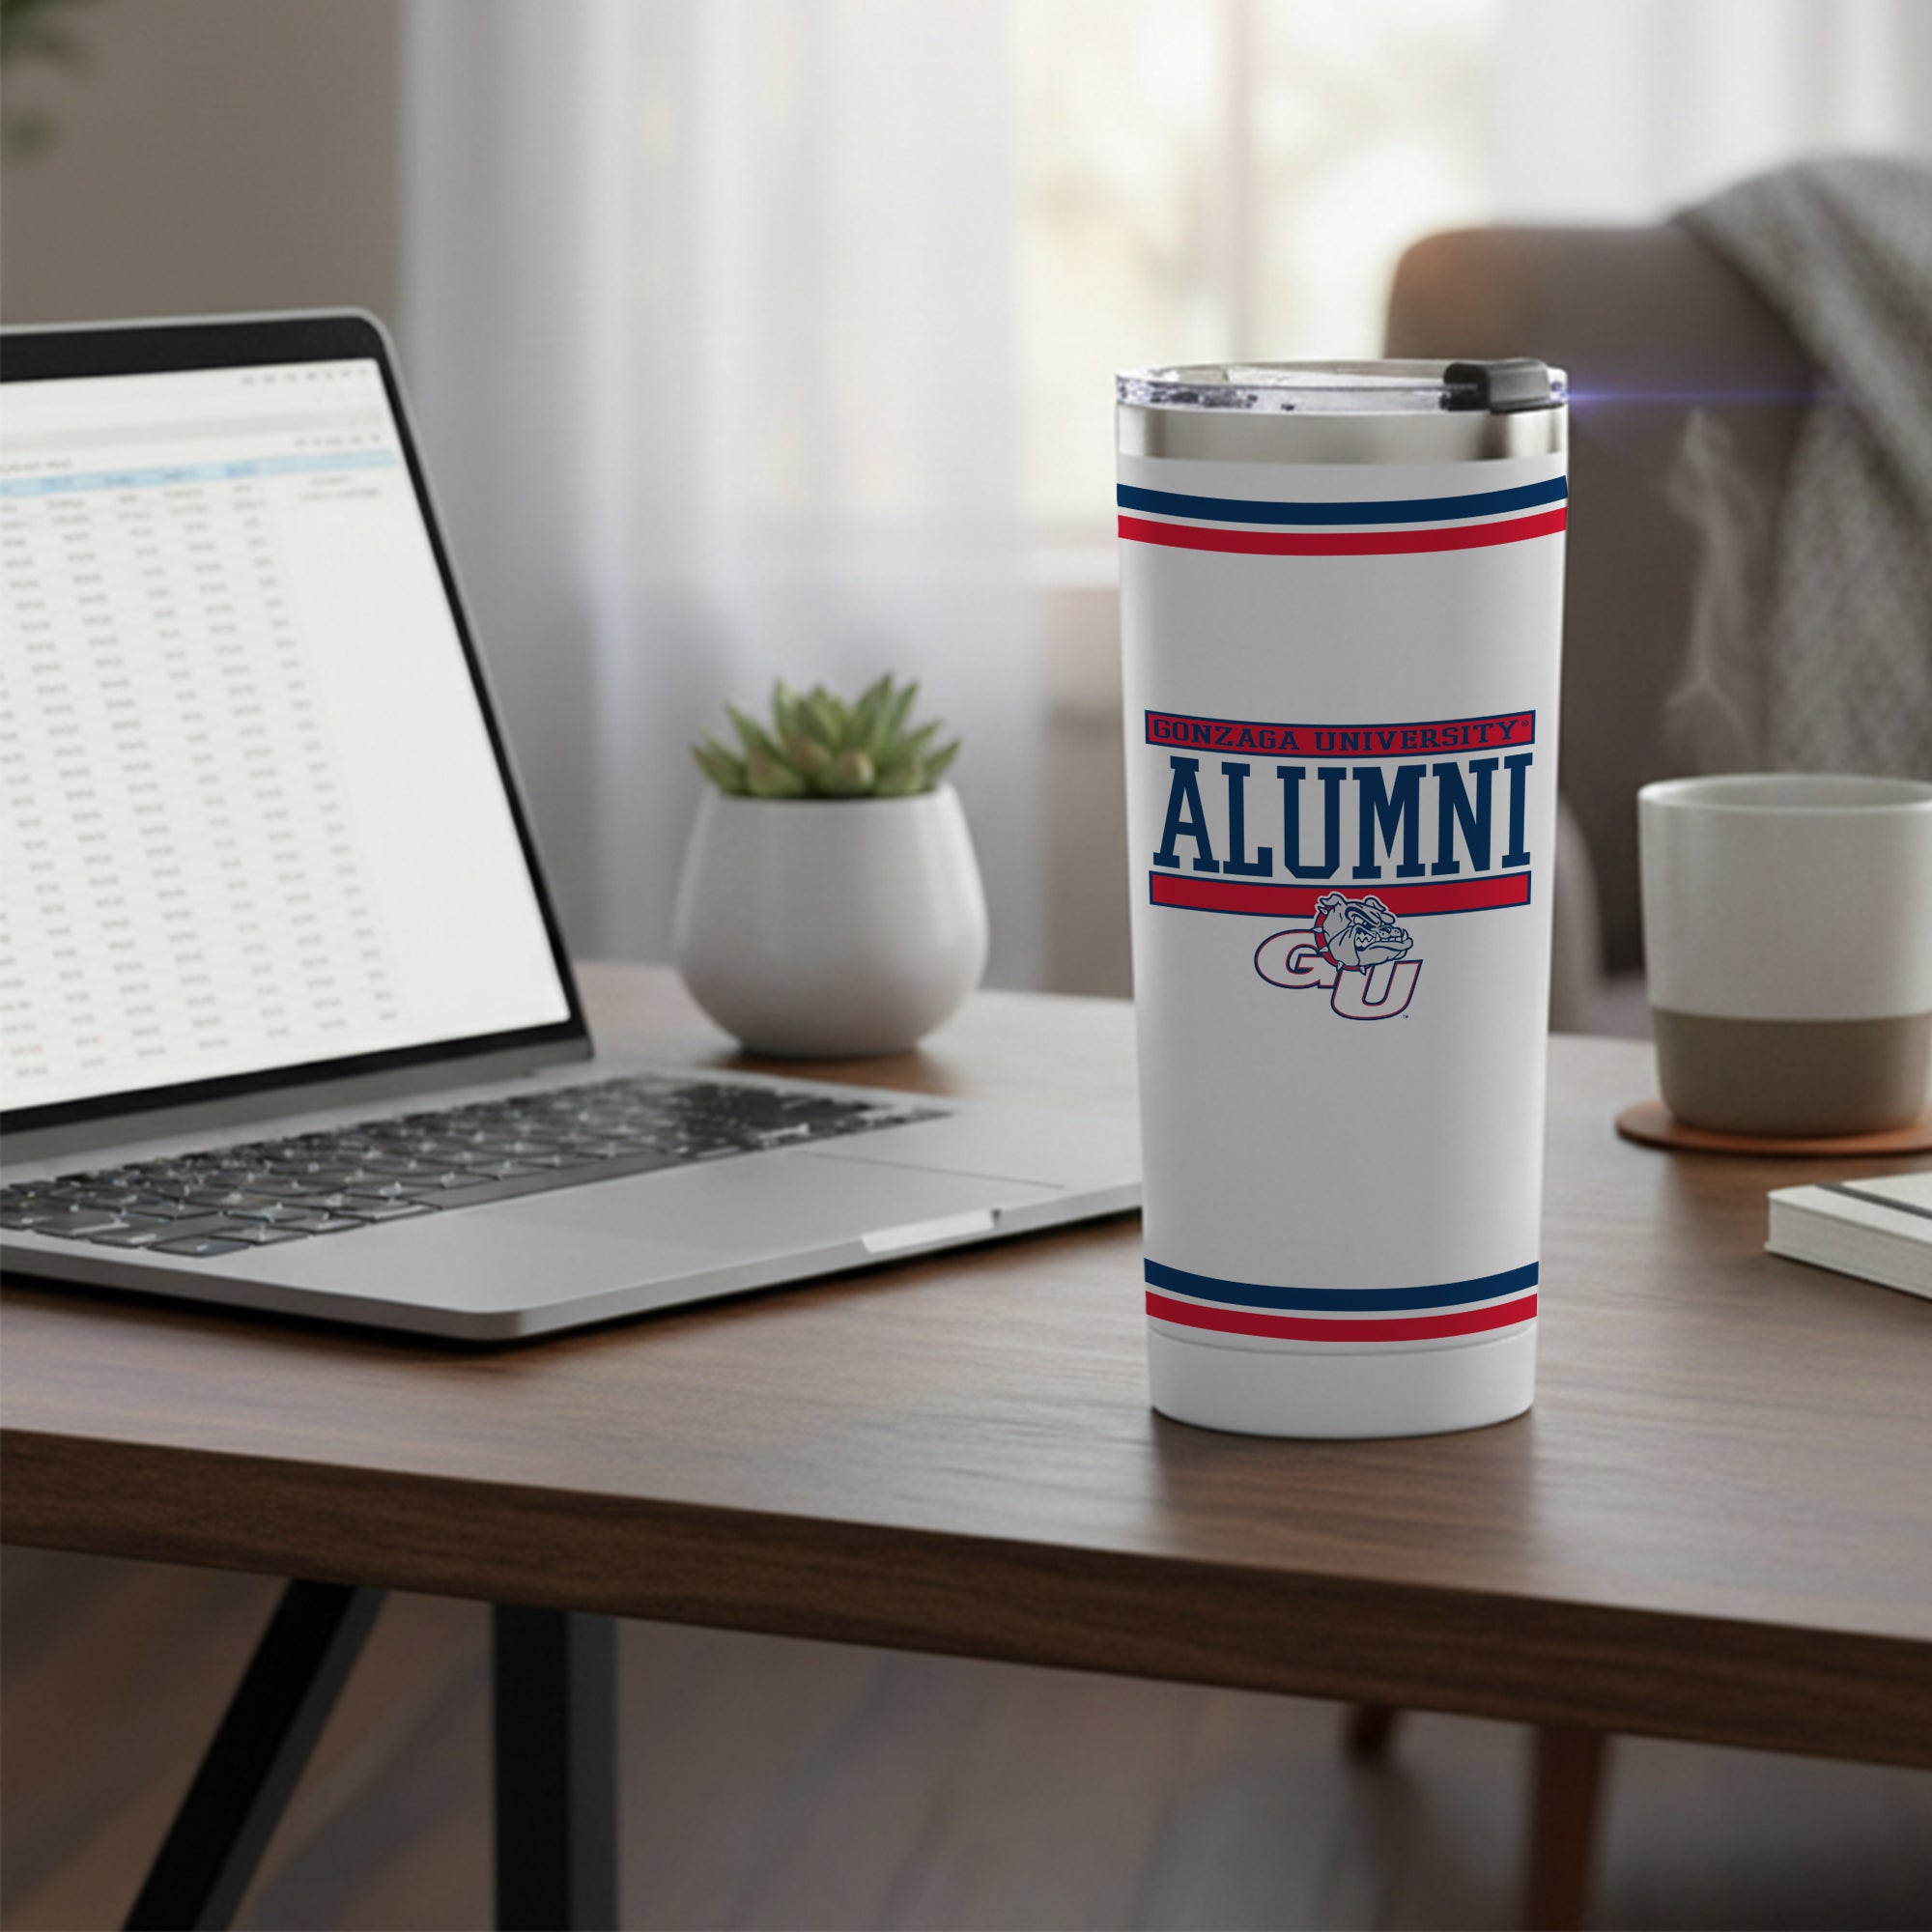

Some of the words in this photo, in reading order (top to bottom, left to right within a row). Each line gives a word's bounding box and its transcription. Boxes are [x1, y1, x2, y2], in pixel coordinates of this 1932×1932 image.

[1152, 719, 1299, 751] GONZAGA
[1153, 753, 1532, 879] ALUMNI
[1254, 929, 1423, 1020] GU
